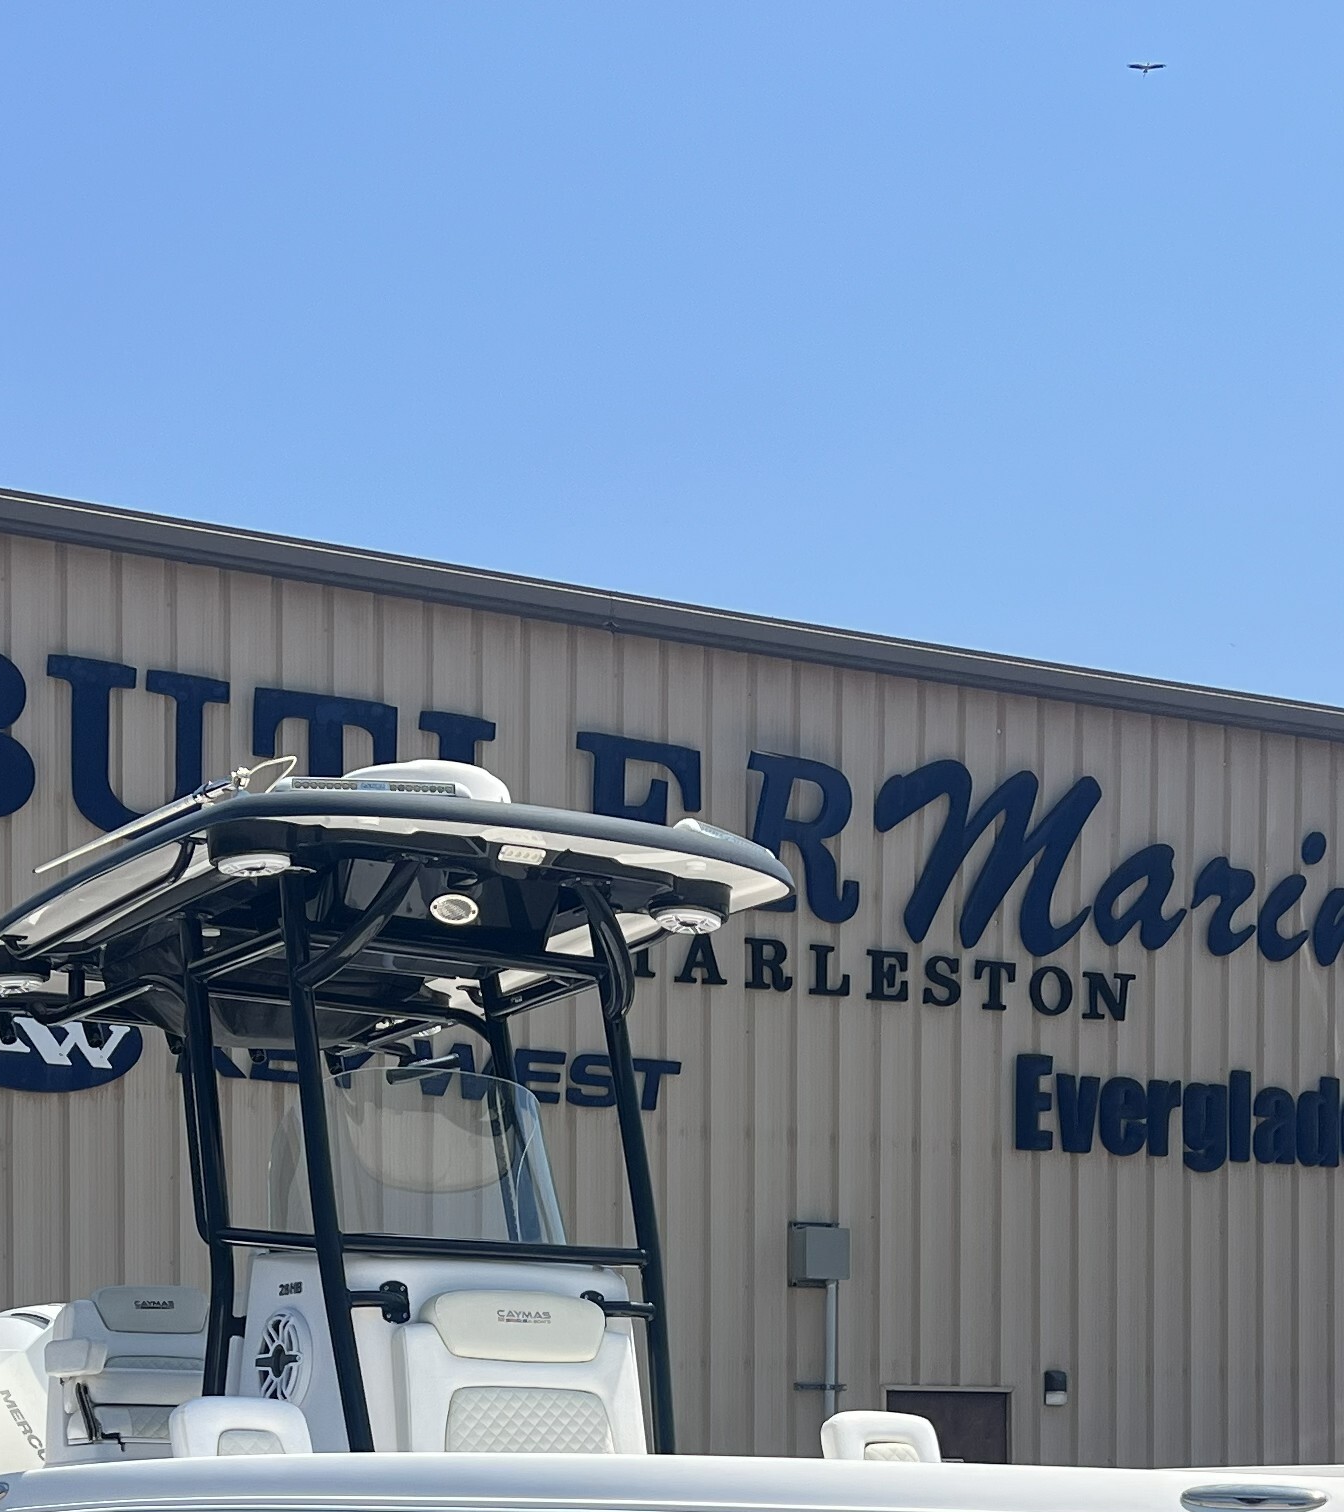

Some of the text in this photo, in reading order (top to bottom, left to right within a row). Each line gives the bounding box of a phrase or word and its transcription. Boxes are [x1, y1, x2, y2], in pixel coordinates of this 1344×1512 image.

[634, 931, 1136, 1023] ARLESTON
[496, 1309, 552, 1319] CAYMAS
[0, 1388, 46, 1462] MERCU
